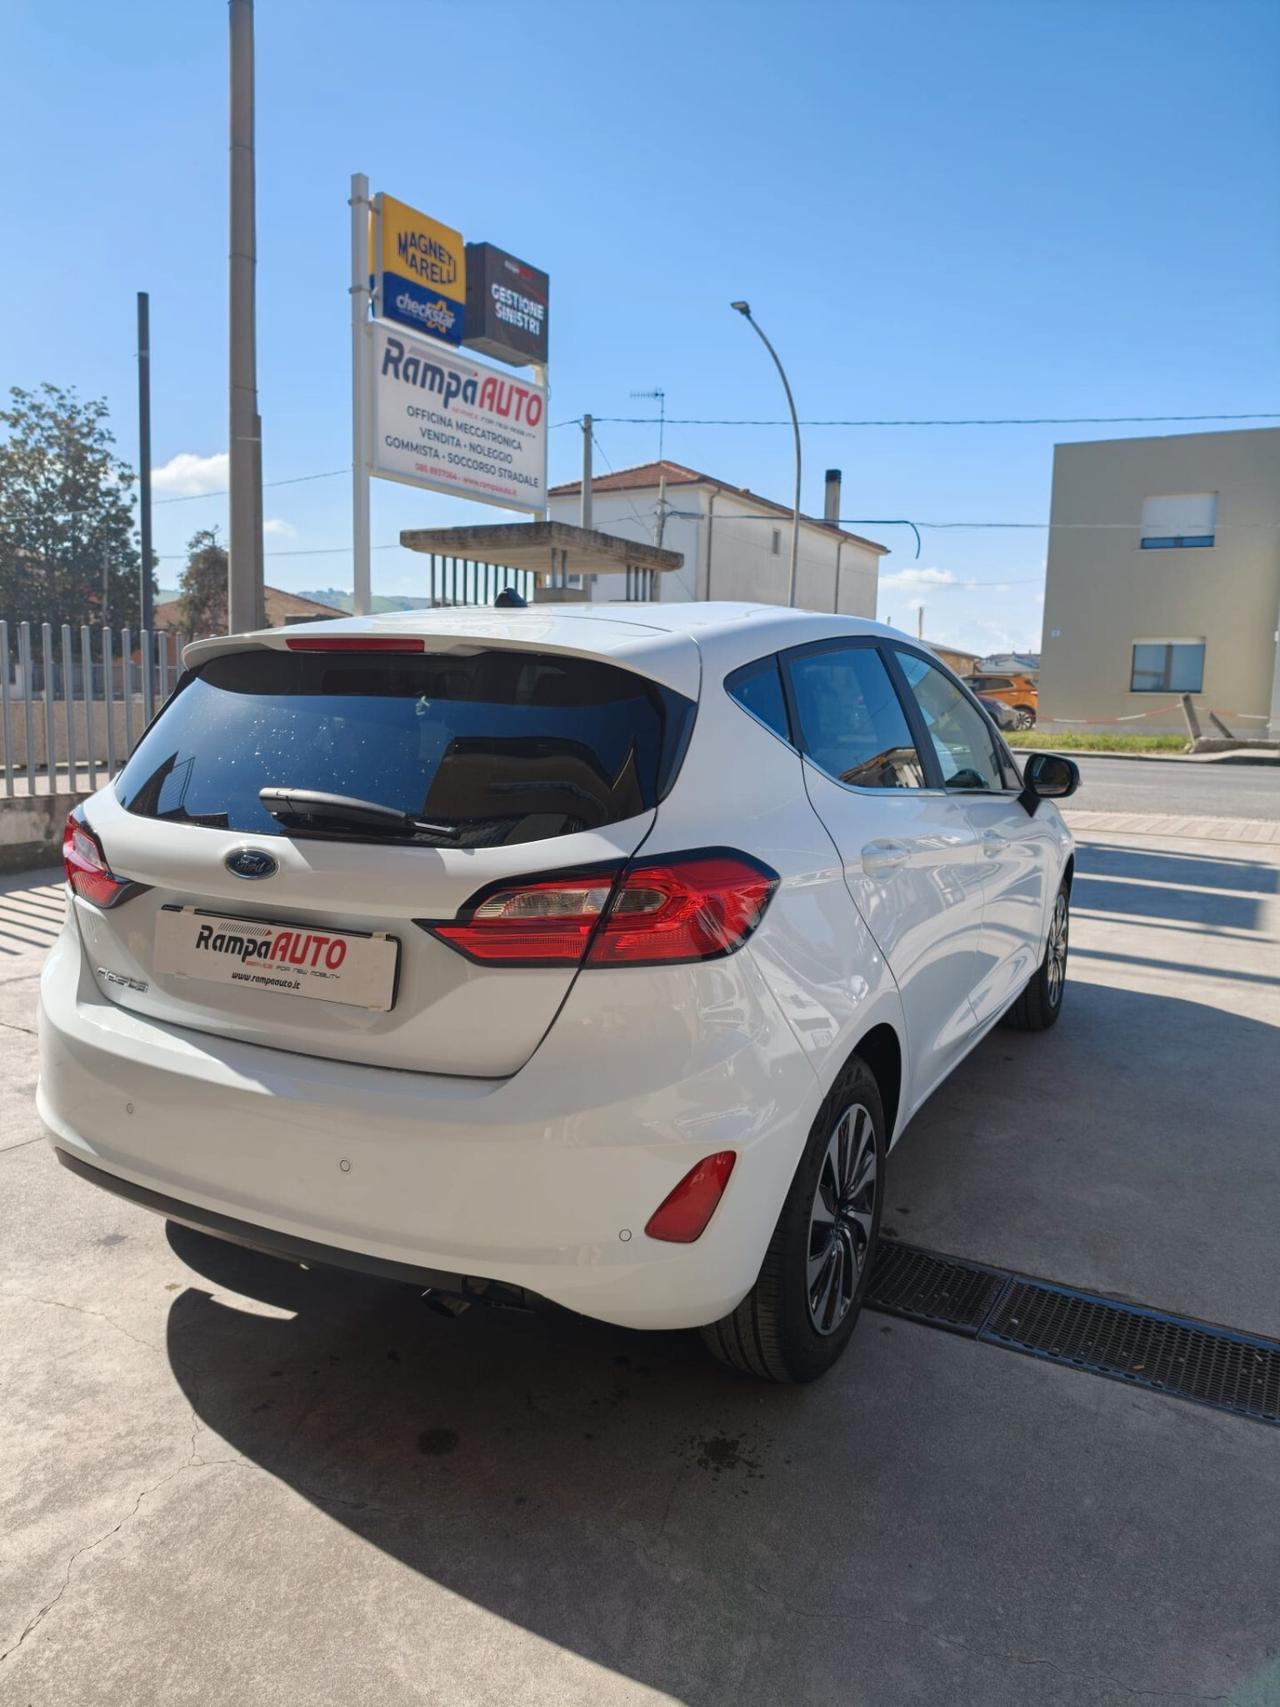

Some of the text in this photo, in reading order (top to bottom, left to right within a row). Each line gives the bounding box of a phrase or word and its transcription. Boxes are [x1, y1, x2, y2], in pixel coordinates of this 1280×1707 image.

[396, 293, 455, 329] checkstar
[491, 283, 545, 322] GESTIONE
[495, 301, 540, 336] SINISTRI
[406, 405, 454, 430] OFFICINA
[455, 419, 523, 452] MECCATRONICA
[419, 427, 513, 465] VENDITA NOLEGGIO
[447, 452, 497, 476] SOCCORSO
[497, 468, 539, 489] STRADALE
[231, 971, 302, 990] www.rampaauto.it
